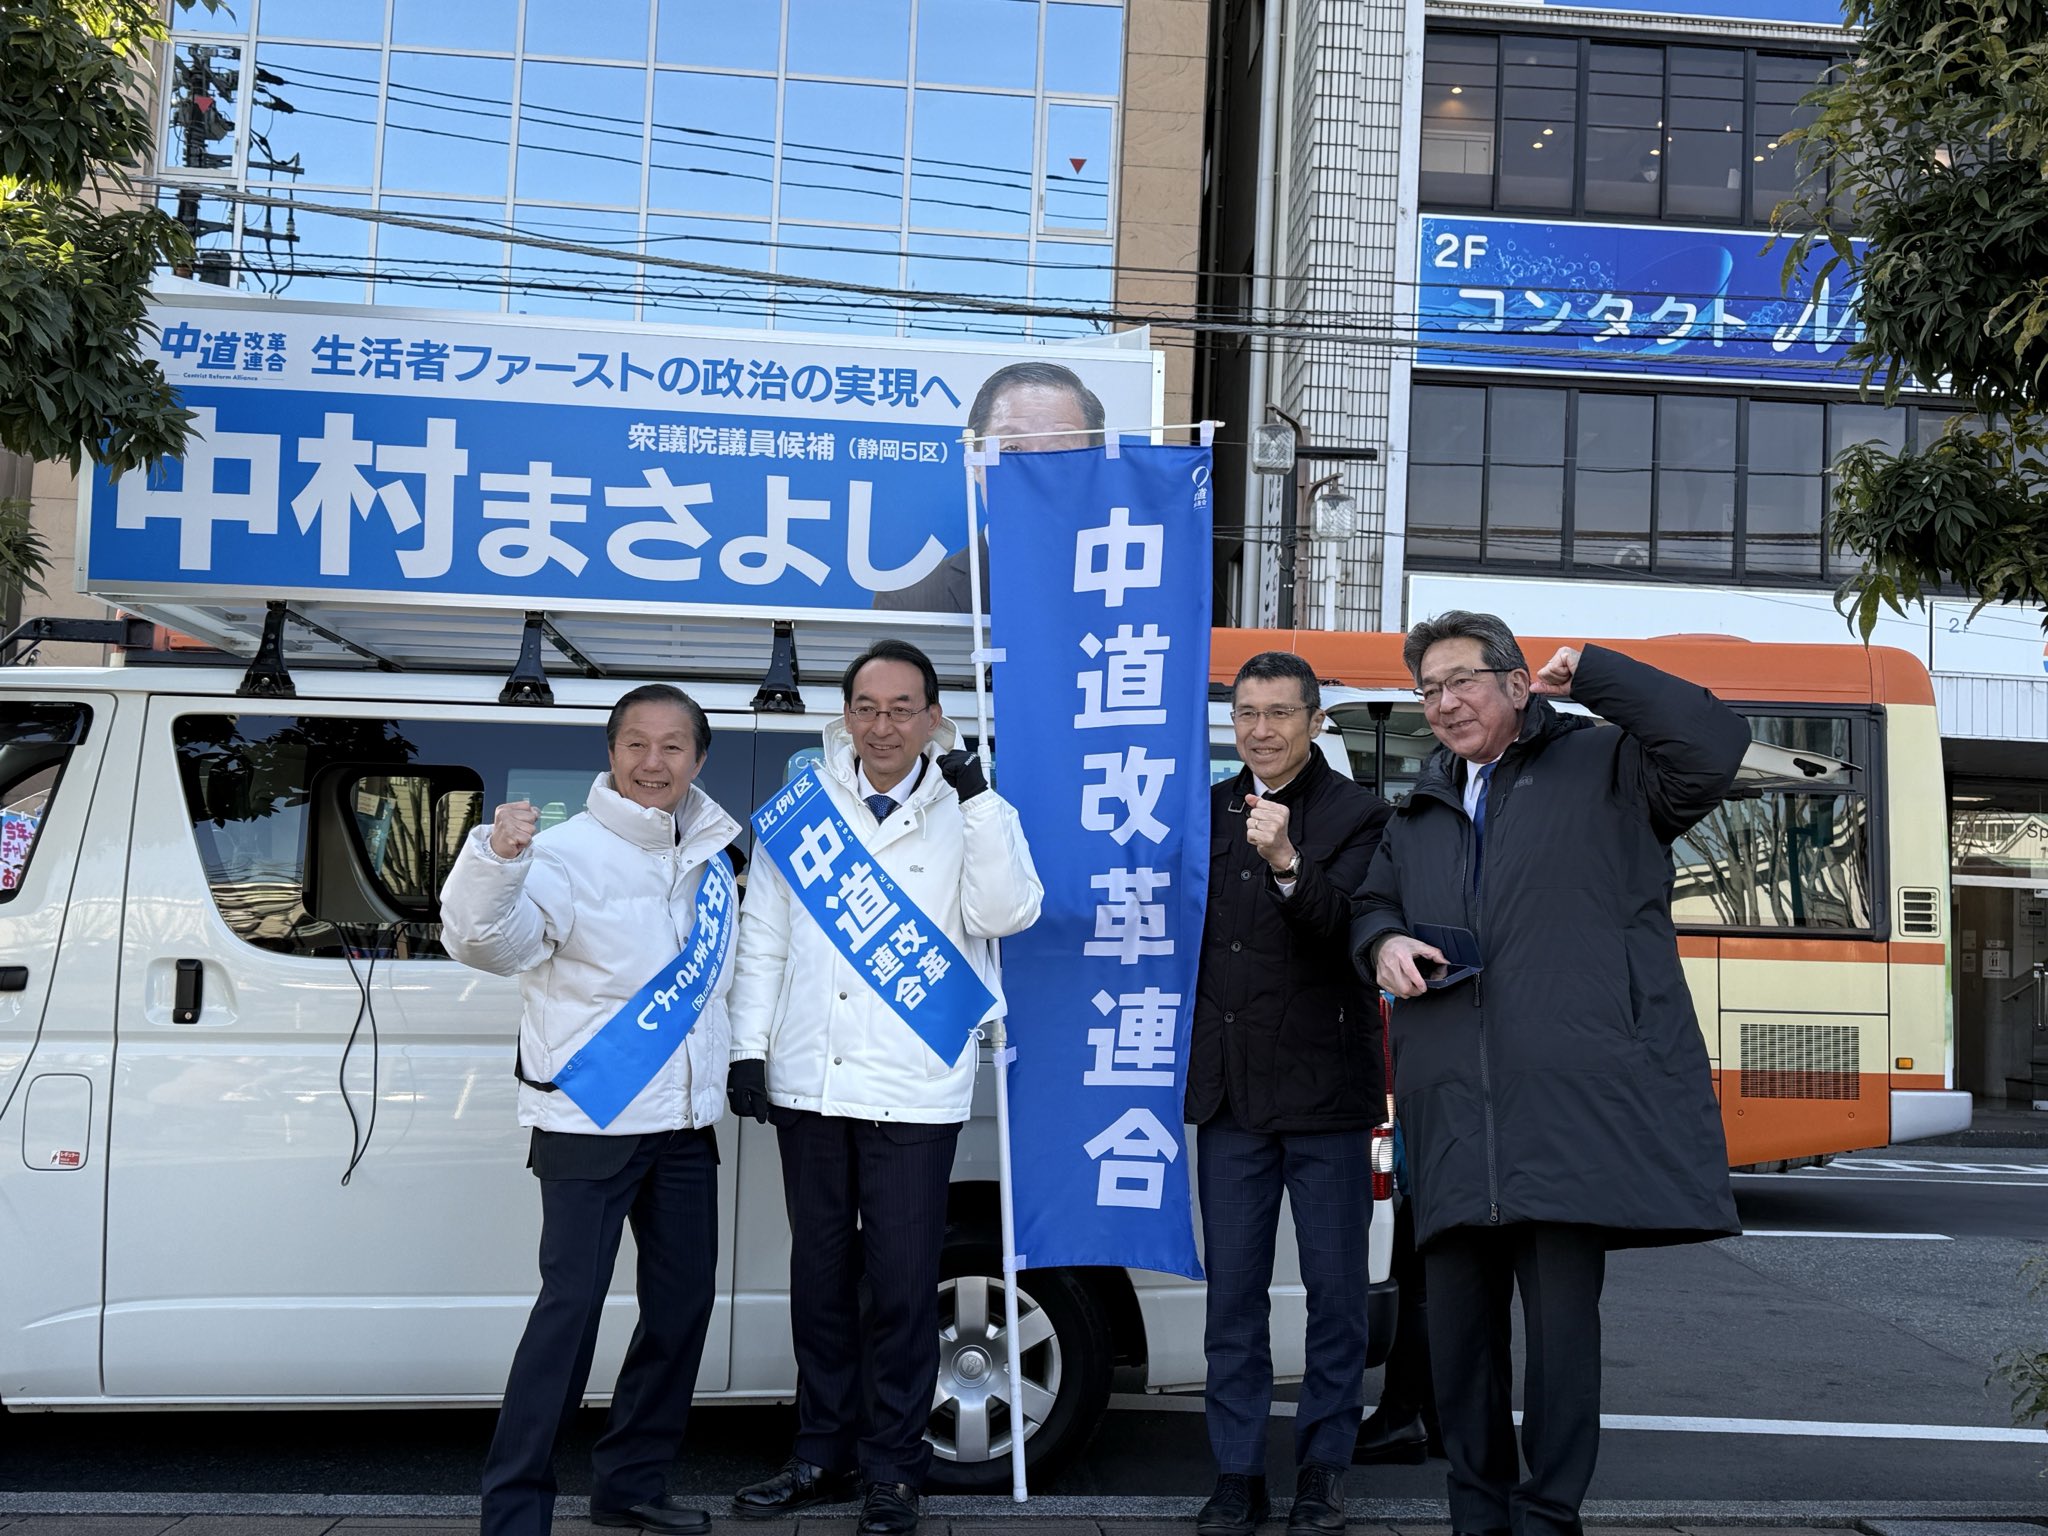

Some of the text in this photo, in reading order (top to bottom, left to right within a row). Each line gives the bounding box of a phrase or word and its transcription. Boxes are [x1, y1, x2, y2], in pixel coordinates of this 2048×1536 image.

[1435, 233, 1488, 269] 2F
[160, 321, 241, 371] 中道
[311, 334, 962, 408] 生活者ファーストの政治の実現へ
[627, 422, 835, 461] 衆議院議員候補
[115, 405, 948, 593] 中村まさよし
[757, 773, 814, 834] 比例区
[1073, 507, 1181, 1210] 中道改革連合
[636, 870, 727, 1031] 中村まさよし
